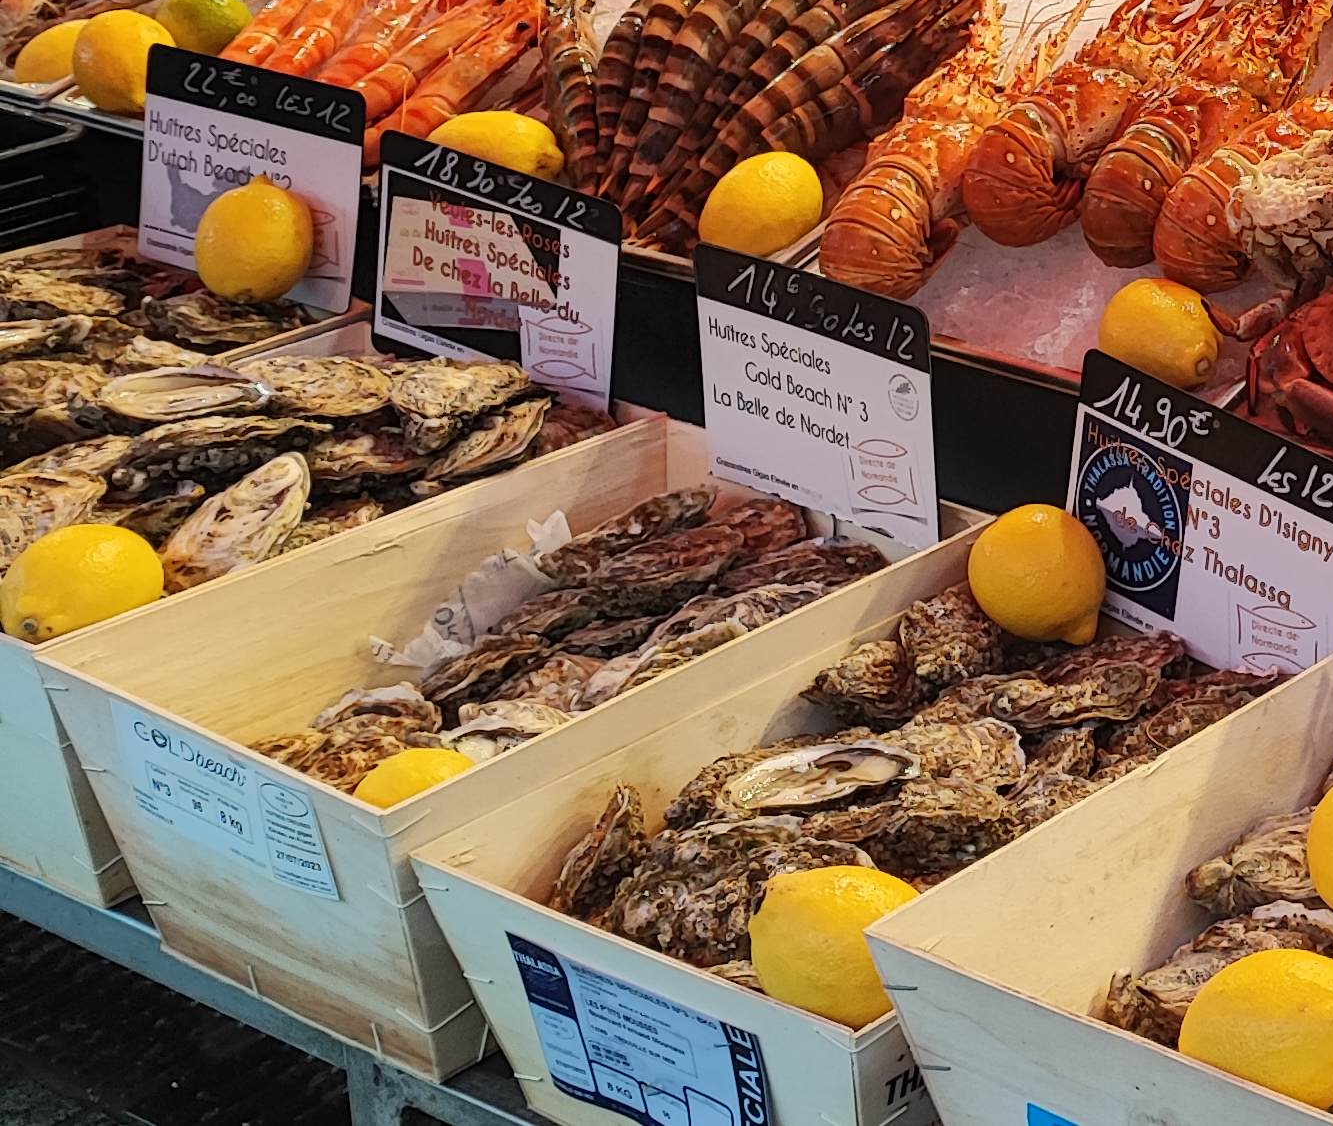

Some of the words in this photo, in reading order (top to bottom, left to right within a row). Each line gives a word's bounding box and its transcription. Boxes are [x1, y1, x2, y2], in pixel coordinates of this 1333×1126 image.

[149, 109, 202, 144] Huîtres
[207, 124, 288, 167] Spéciales
[321, 99, 353, 134] 12
[411, 247, 435, 271] De
[440, 257, 483, 289] chez
[487, 268, 504, 297] la
[509, 282, 551, 314] Belle
[423, 220, 482, 258] Huîtres
[485, 243, 571, 292] Spéciales
[708, 315, 756, 350] Huîtres
[761, 332, 831, 374] Spéciales
[737, 393, 770, 420] Belle
[744, 361, 782, 392] Gold
[786, 375, 832, 410] Beach
